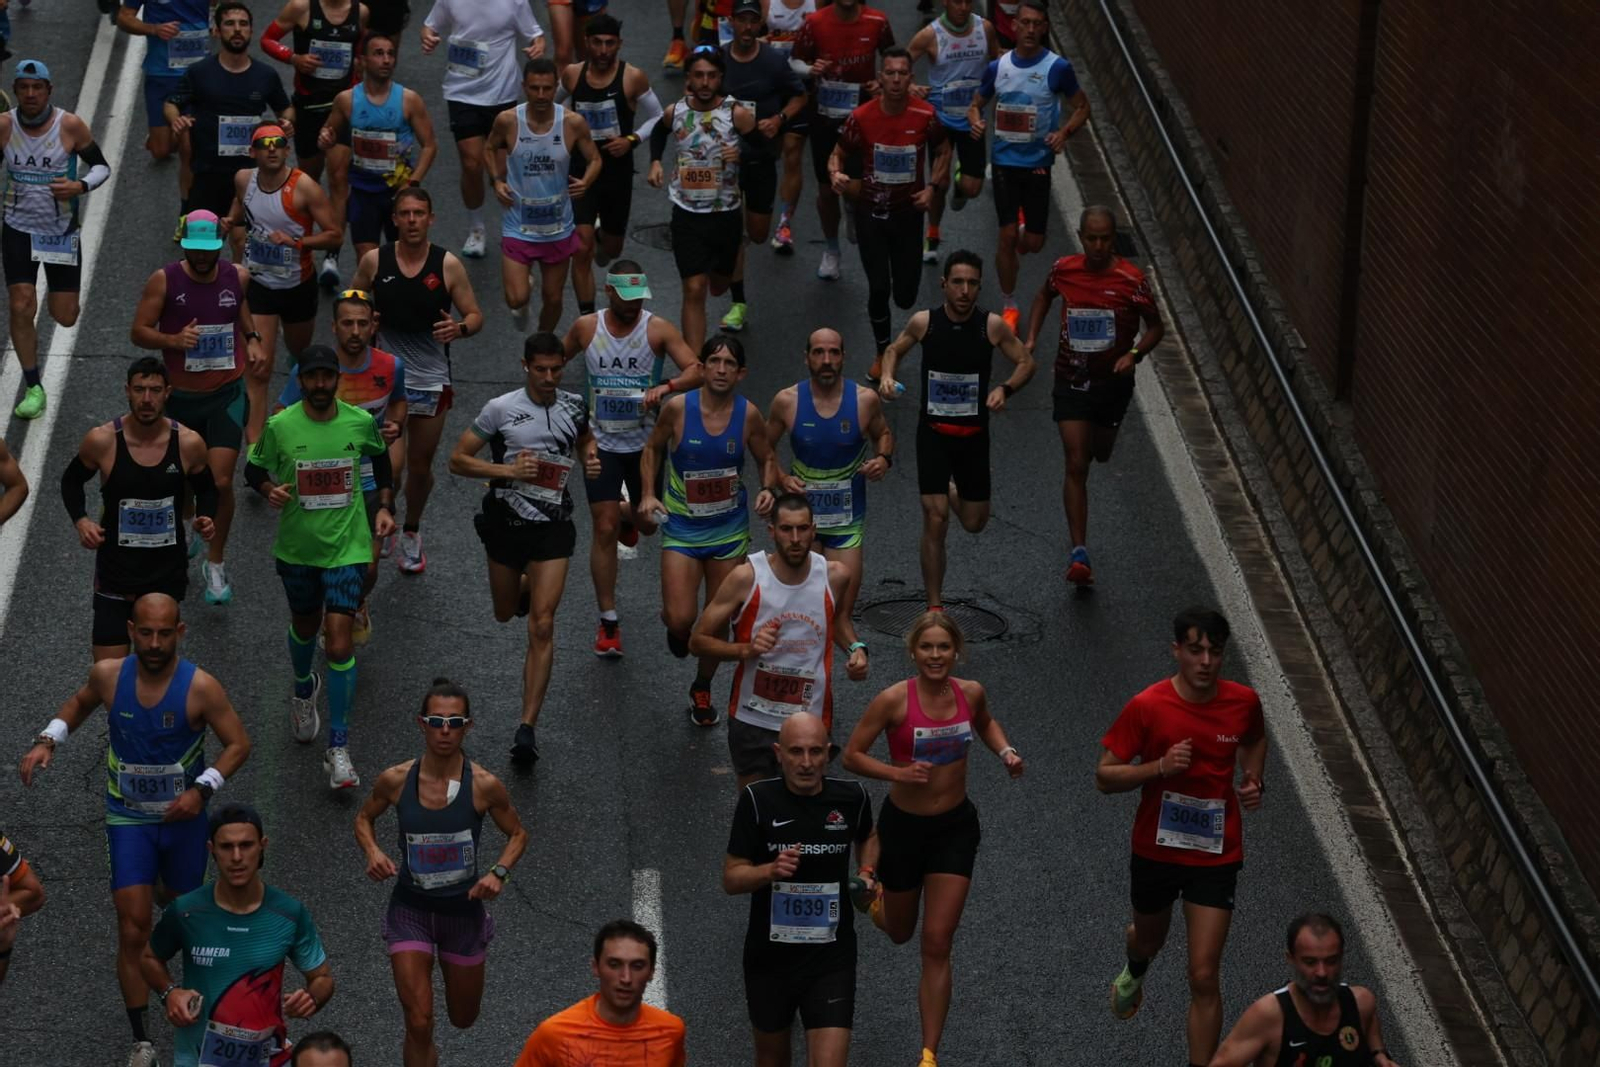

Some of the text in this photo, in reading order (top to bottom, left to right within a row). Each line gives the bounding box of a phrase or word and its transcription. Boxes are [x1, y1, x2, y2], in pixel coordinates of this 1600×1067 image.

[14, 156, 52, 168] LAR
[684, 170, 712, 183] 4059
[1074, 319, 1102, 334] 1787
[600, 356, 638, 369] LAR
[602, 399, 633, 413] 1920
[305, 472, 341, 488] 1303
[697, 483, 723, 496] 815
[810, 492, 840, 507] 2706
[128, 511, 169, 526] 3215
[764, 677, 800, 696] 1120
[130, 777, 168, 794] 1831
[1169, 807, 1210, 830] 3048
[782, 898, 825, 918] 1639
[191, 946, 231, 957] ALAMEDA
[213, 1038, 259, 1061] 2079
